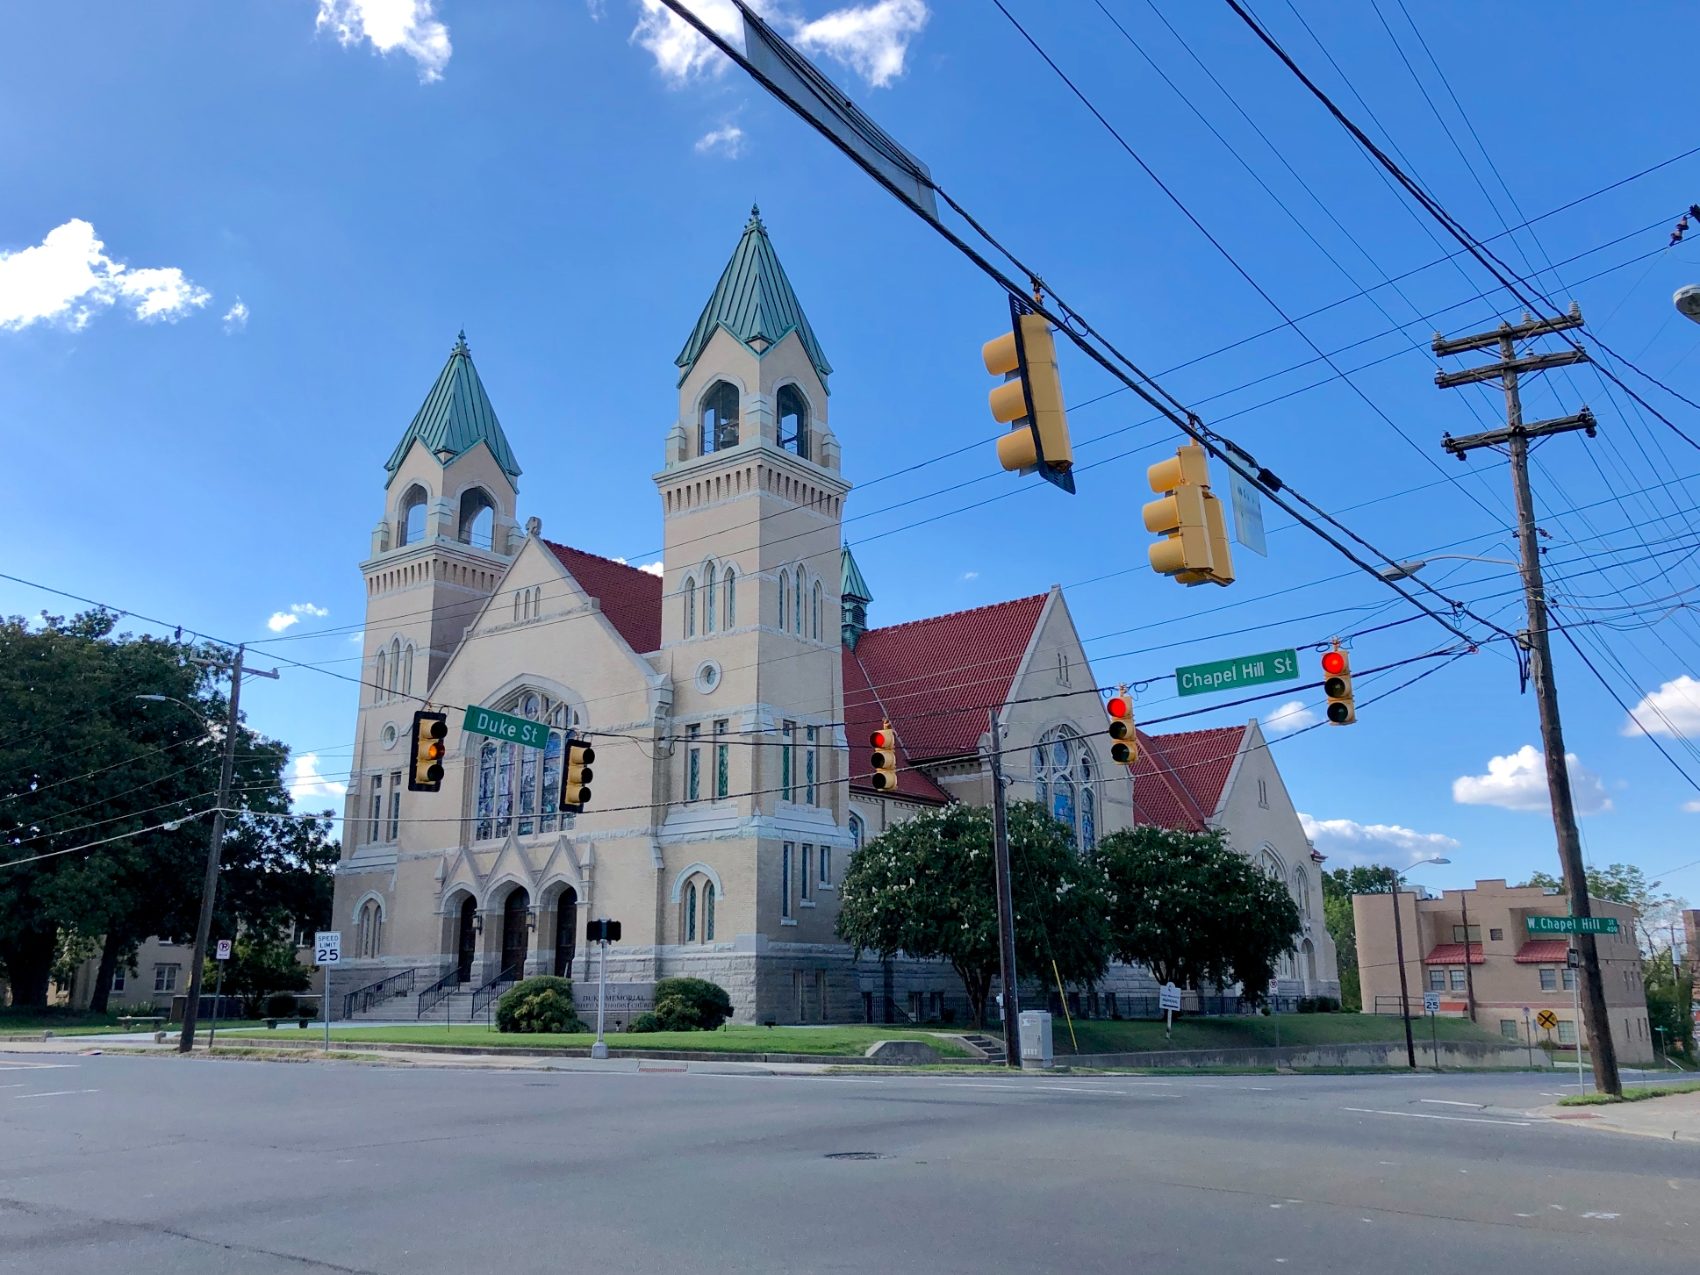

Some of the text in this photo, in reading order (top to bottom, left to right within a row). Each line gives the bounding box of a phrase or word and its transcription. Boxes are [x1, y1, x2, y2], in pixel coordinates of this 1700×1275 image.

[1182, 657, 1293, 688] Chapel Hill St
[477, 713, 538, 743] Duke St
[1527, 918, 1539, 929] W.
[1540, 917, 1577, 931] Chapel
[1581, 918, 1601, 930] Hill
[317, 949, 339, 961] 25
[583, 994, 646, 1002] DUK MEMORIAL
[1426, 1001, 1439, 1010] 25
